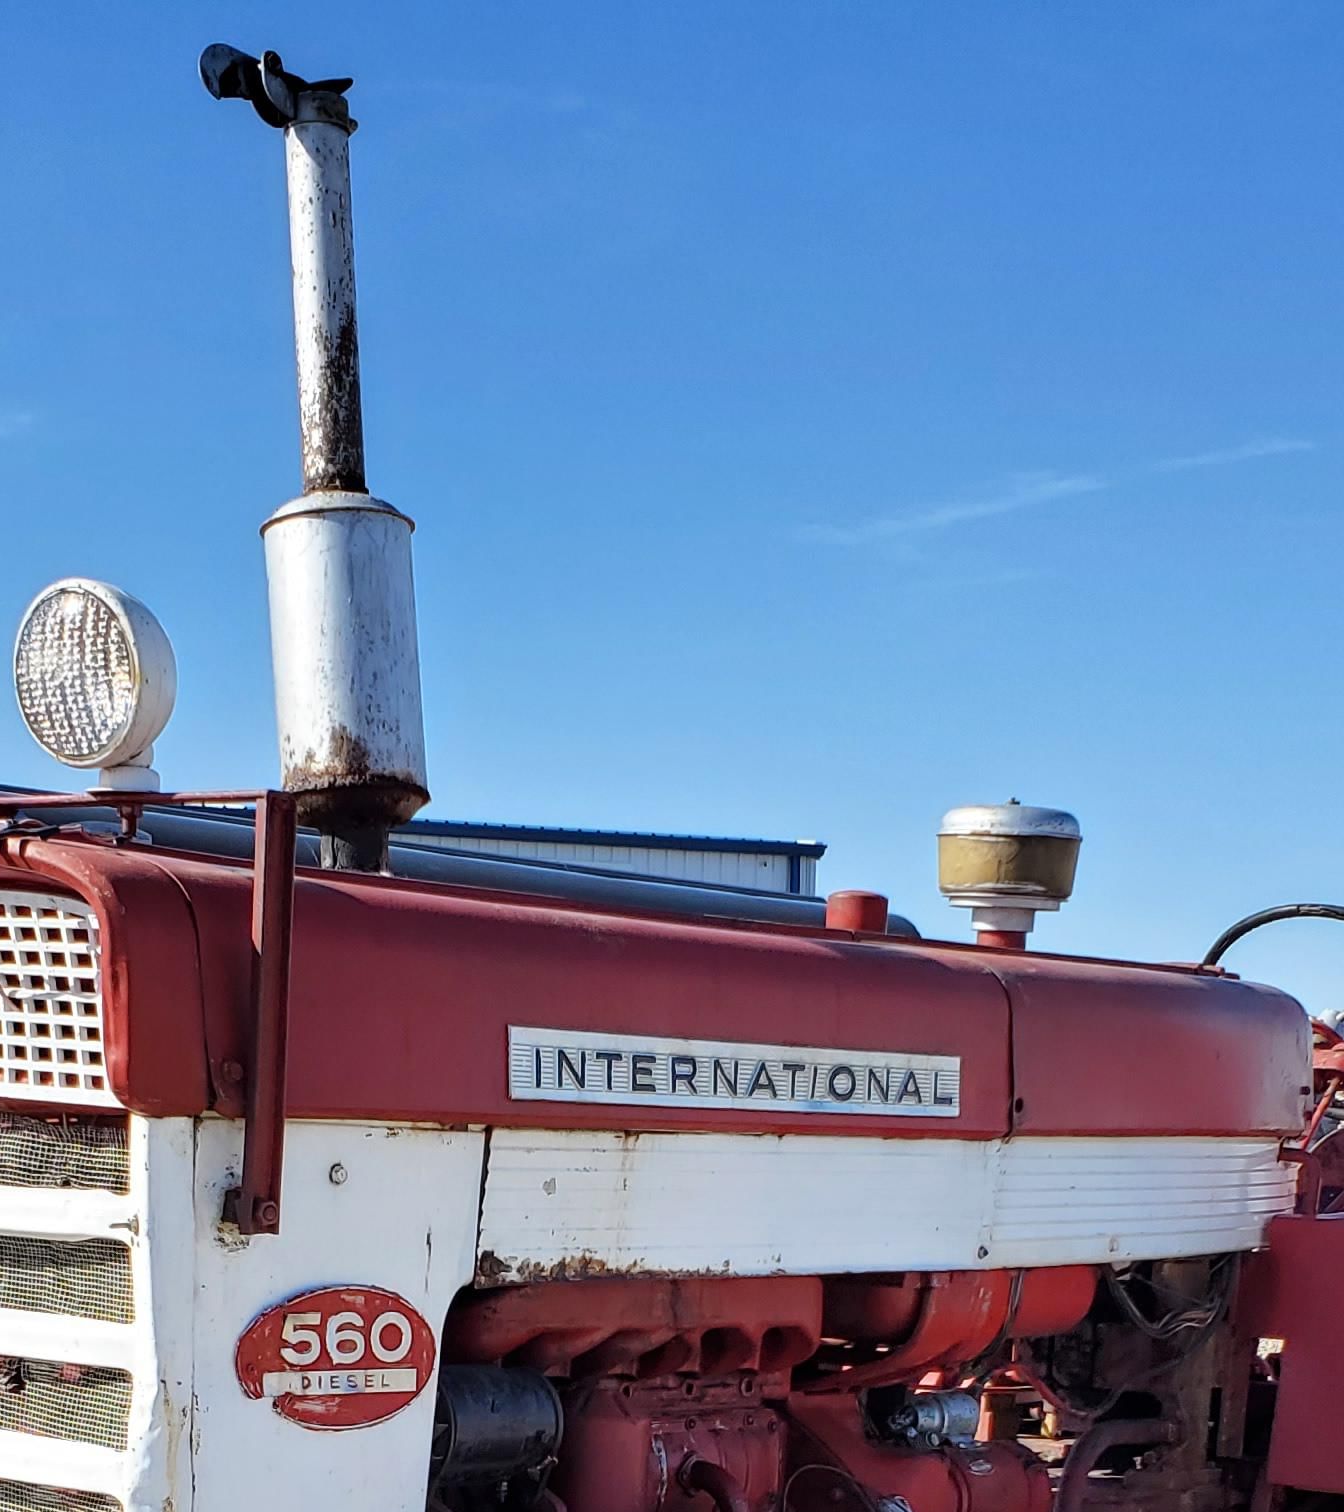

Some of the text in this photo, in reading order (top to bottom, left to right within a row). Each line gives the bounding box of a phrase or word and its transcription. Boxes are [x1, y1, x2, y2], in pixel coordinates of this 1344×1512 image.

[534, 1048, 954, 1106] INTERNATIONAL
[280, 1311, 413, 1366] 560
[301, 1373, 391, 1390] DIESEL
